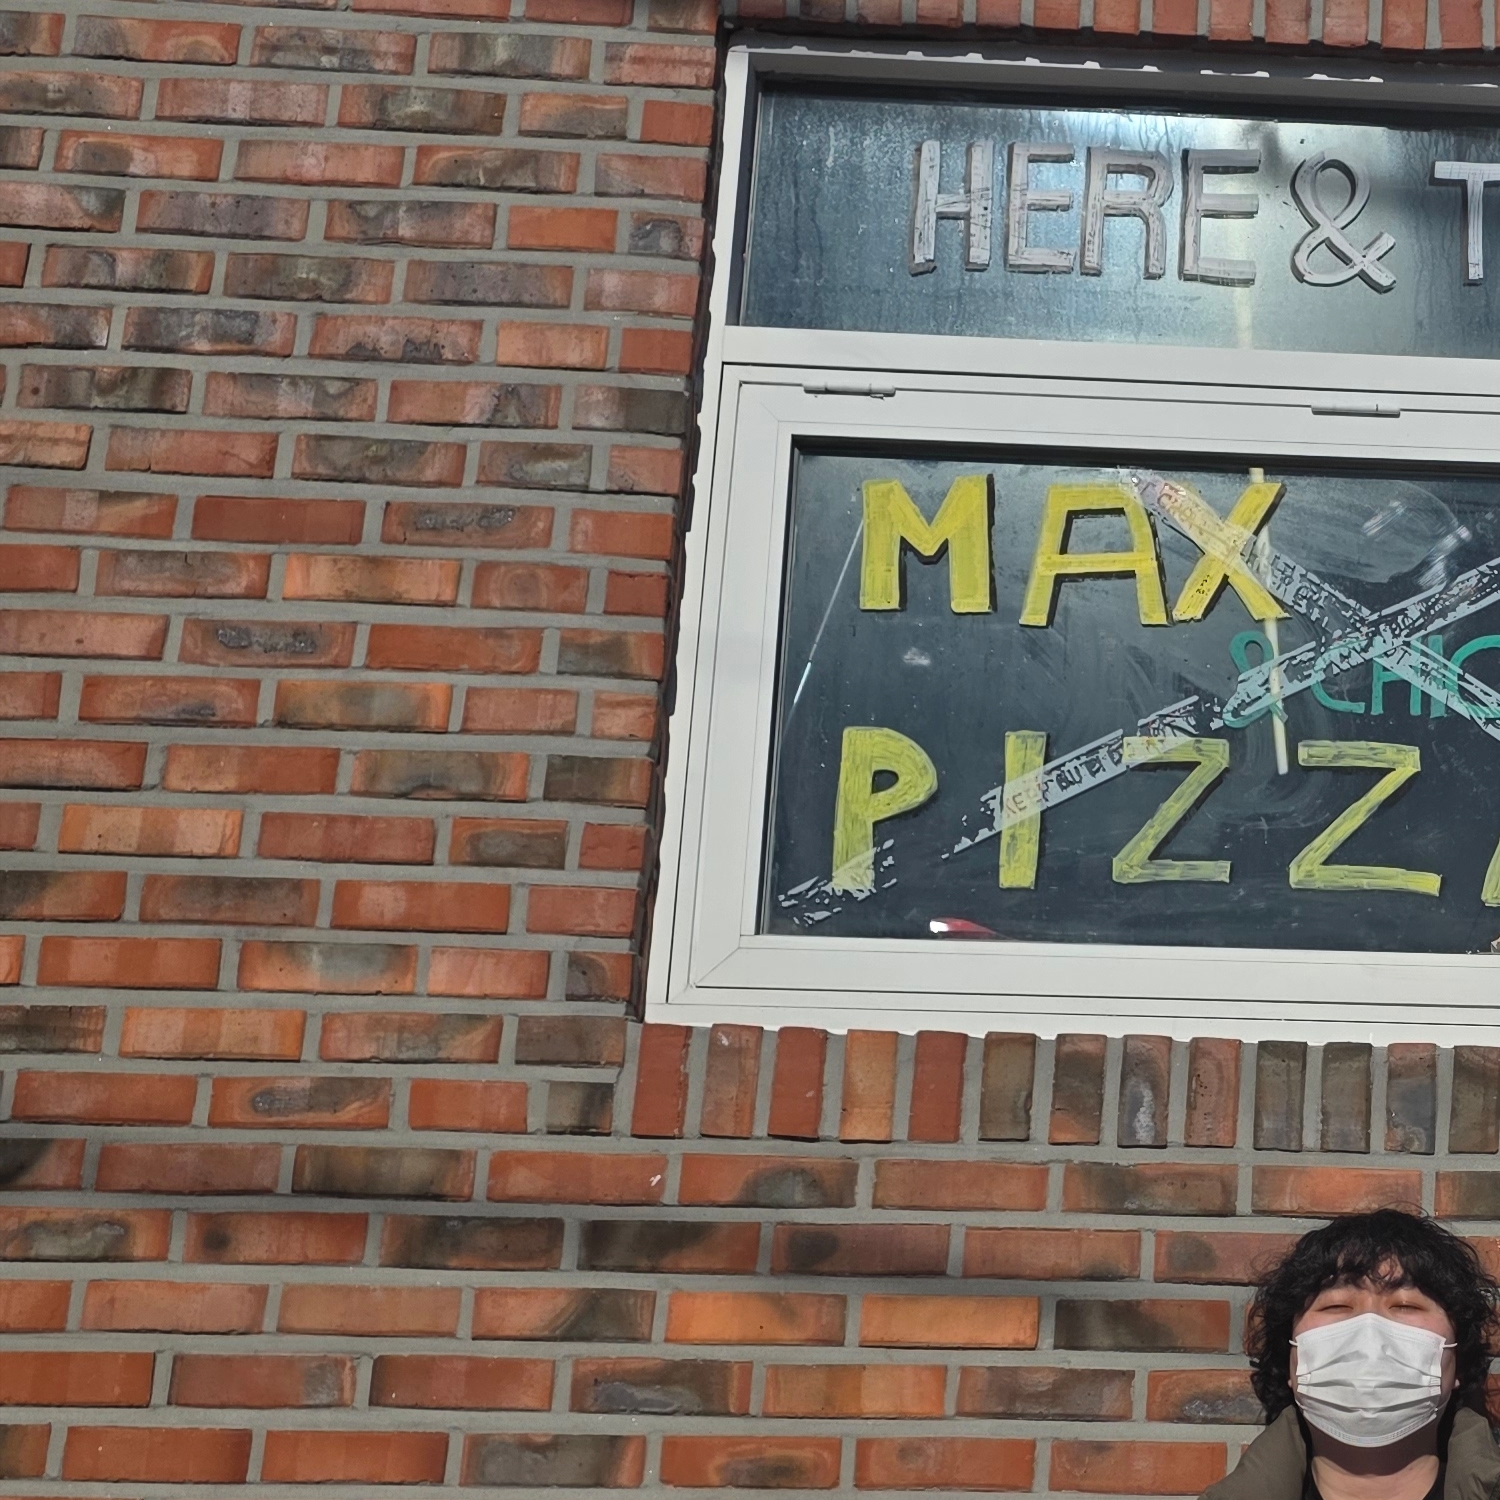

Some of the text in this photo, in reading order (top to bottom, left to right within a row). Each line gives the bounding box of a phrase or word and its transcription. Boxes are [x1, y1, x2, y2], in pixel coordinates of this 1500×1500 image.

[910, 139, 1262, 286] HERE
[1290, 150, 1396, 293] &
[859, 473, 1291, 628] MAX
